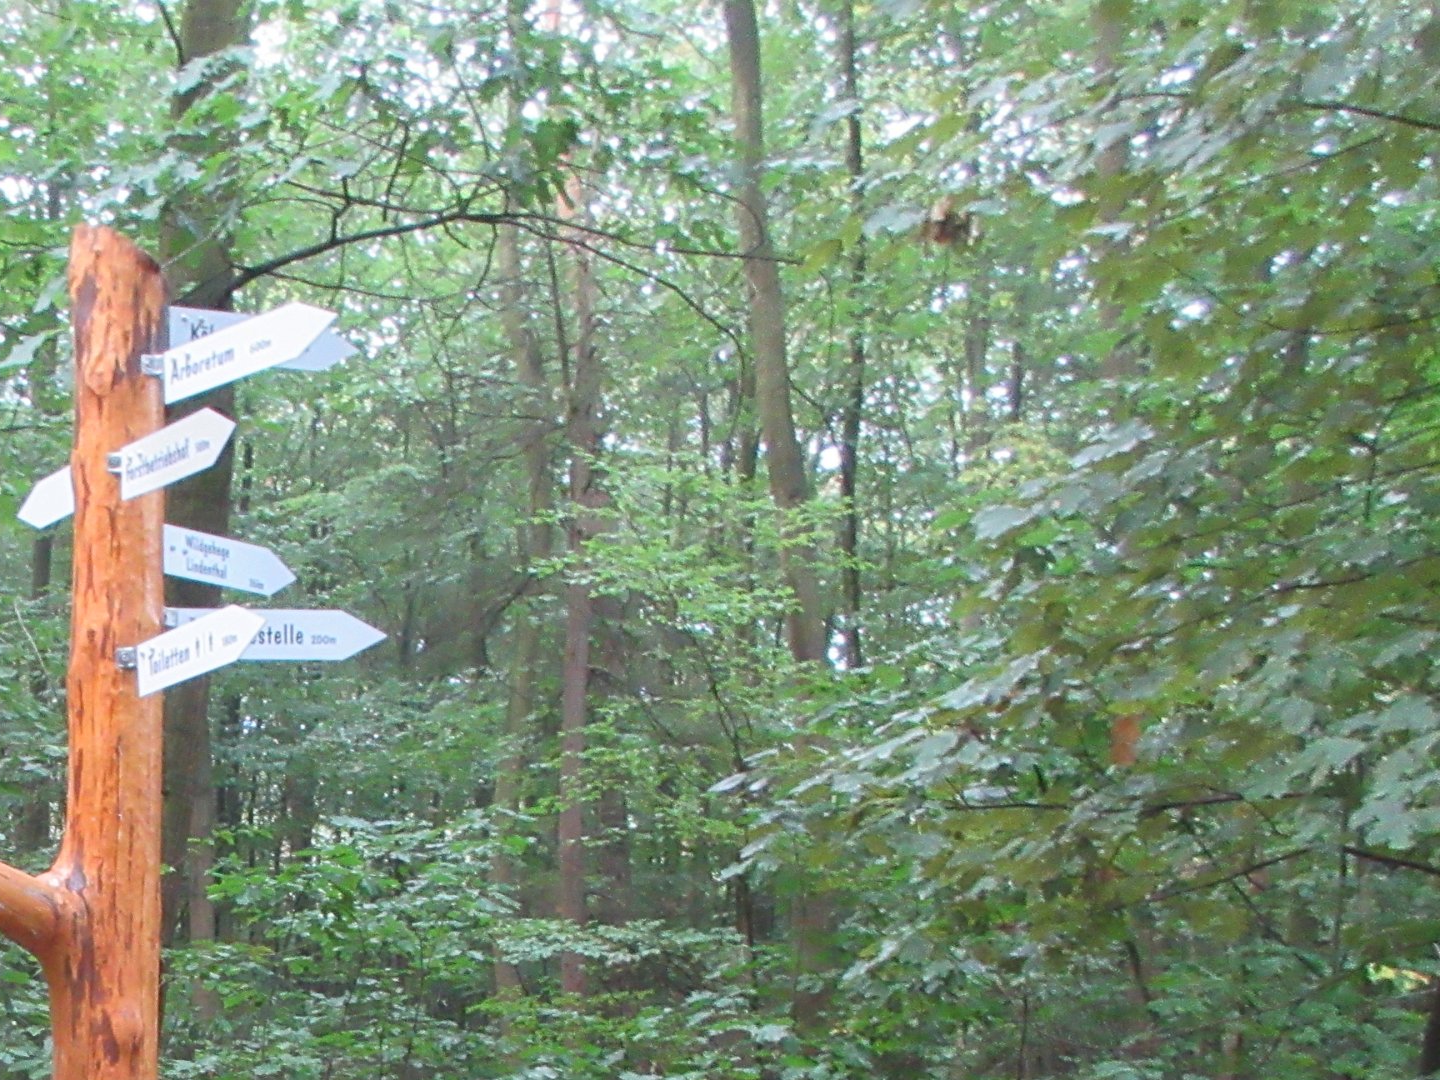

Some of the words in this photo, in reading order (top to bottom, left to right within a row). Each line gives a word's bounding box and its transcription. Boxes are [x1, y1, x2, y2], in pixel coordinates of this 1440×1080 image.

[171, 347, 235, 384] Arboretum
[185, 535, 230, 561] Wildgehege
[187, 557, 228, 579] Lindenthal
[311, 635, 337, 645] 200m
[149, 646, 190, 676] Toiletten
